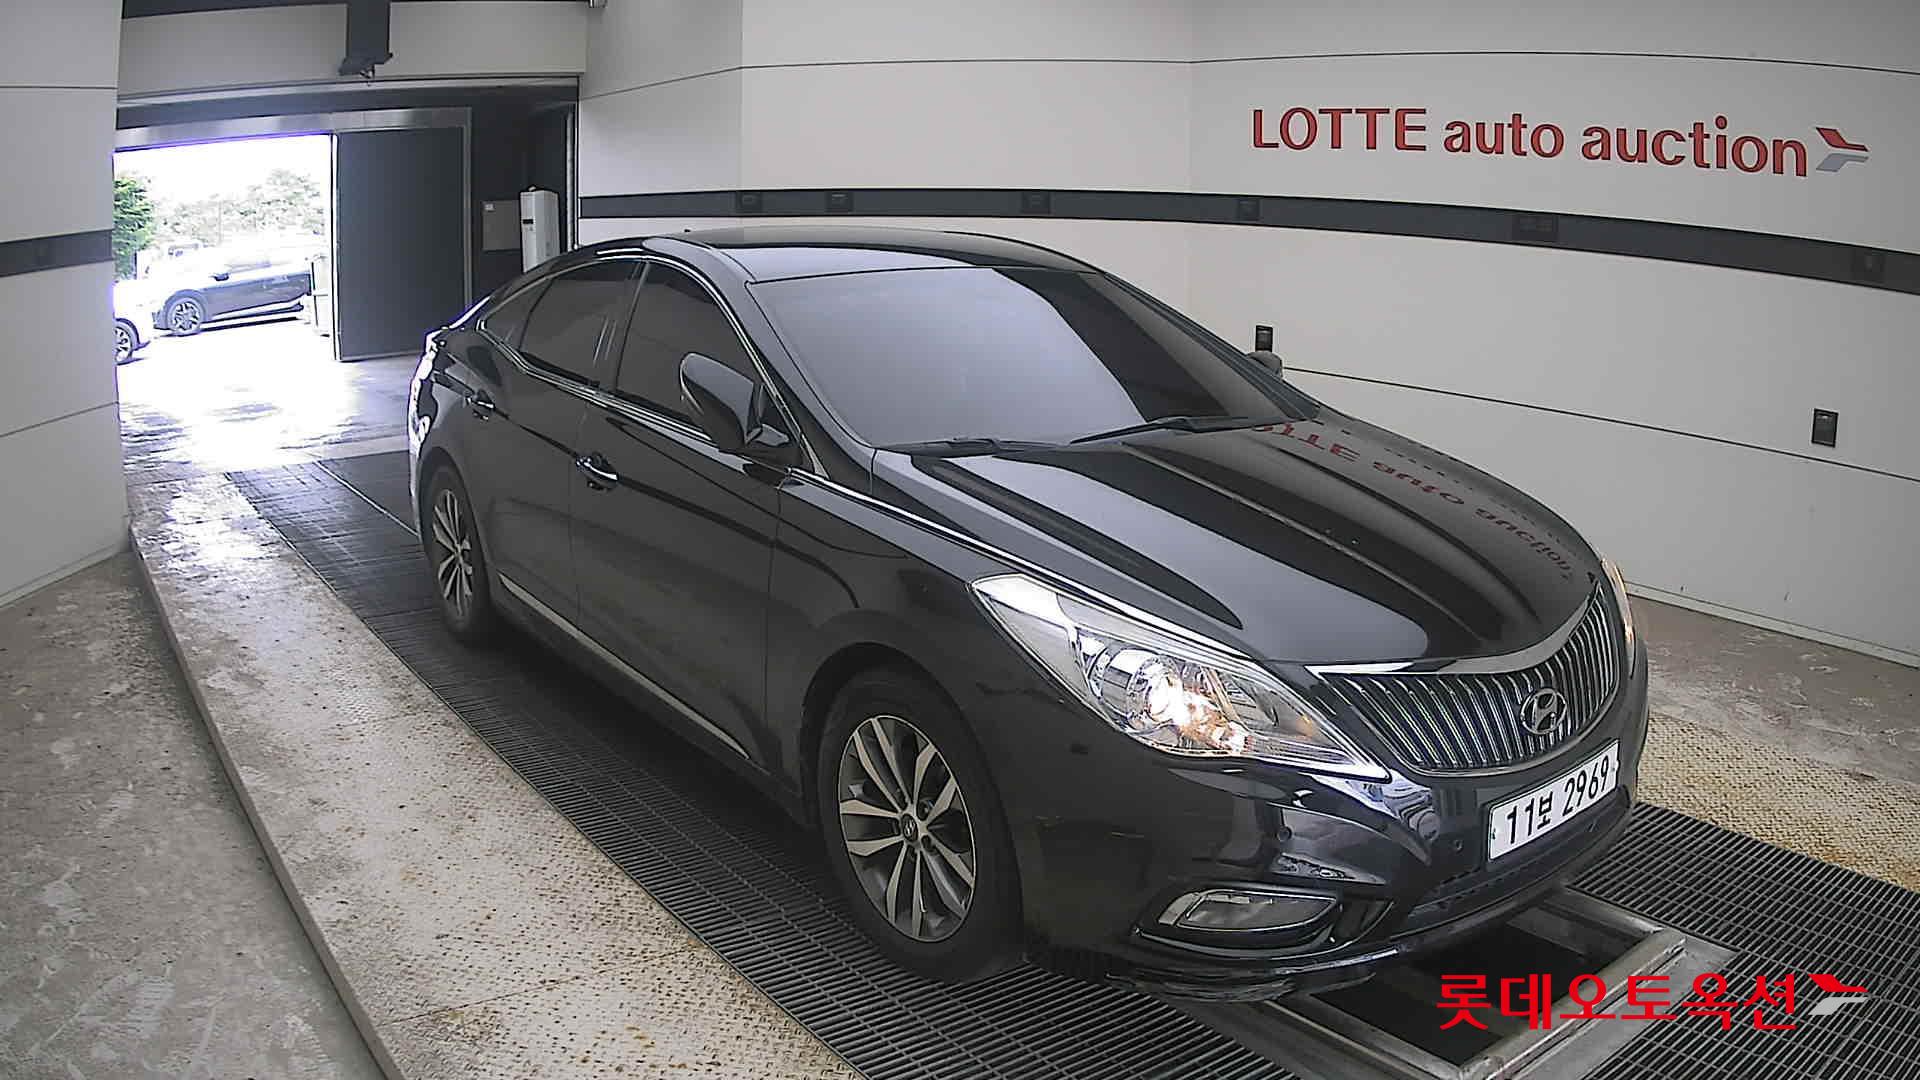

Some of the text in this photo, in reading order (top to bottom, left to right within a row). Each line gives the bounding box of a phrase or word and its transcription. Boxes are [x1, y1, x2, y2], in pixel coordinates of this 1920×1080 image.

[1253, 107, 1808, 178] LOTTE auto auction
[1507, 754, 1609, 845] 11보 2969
